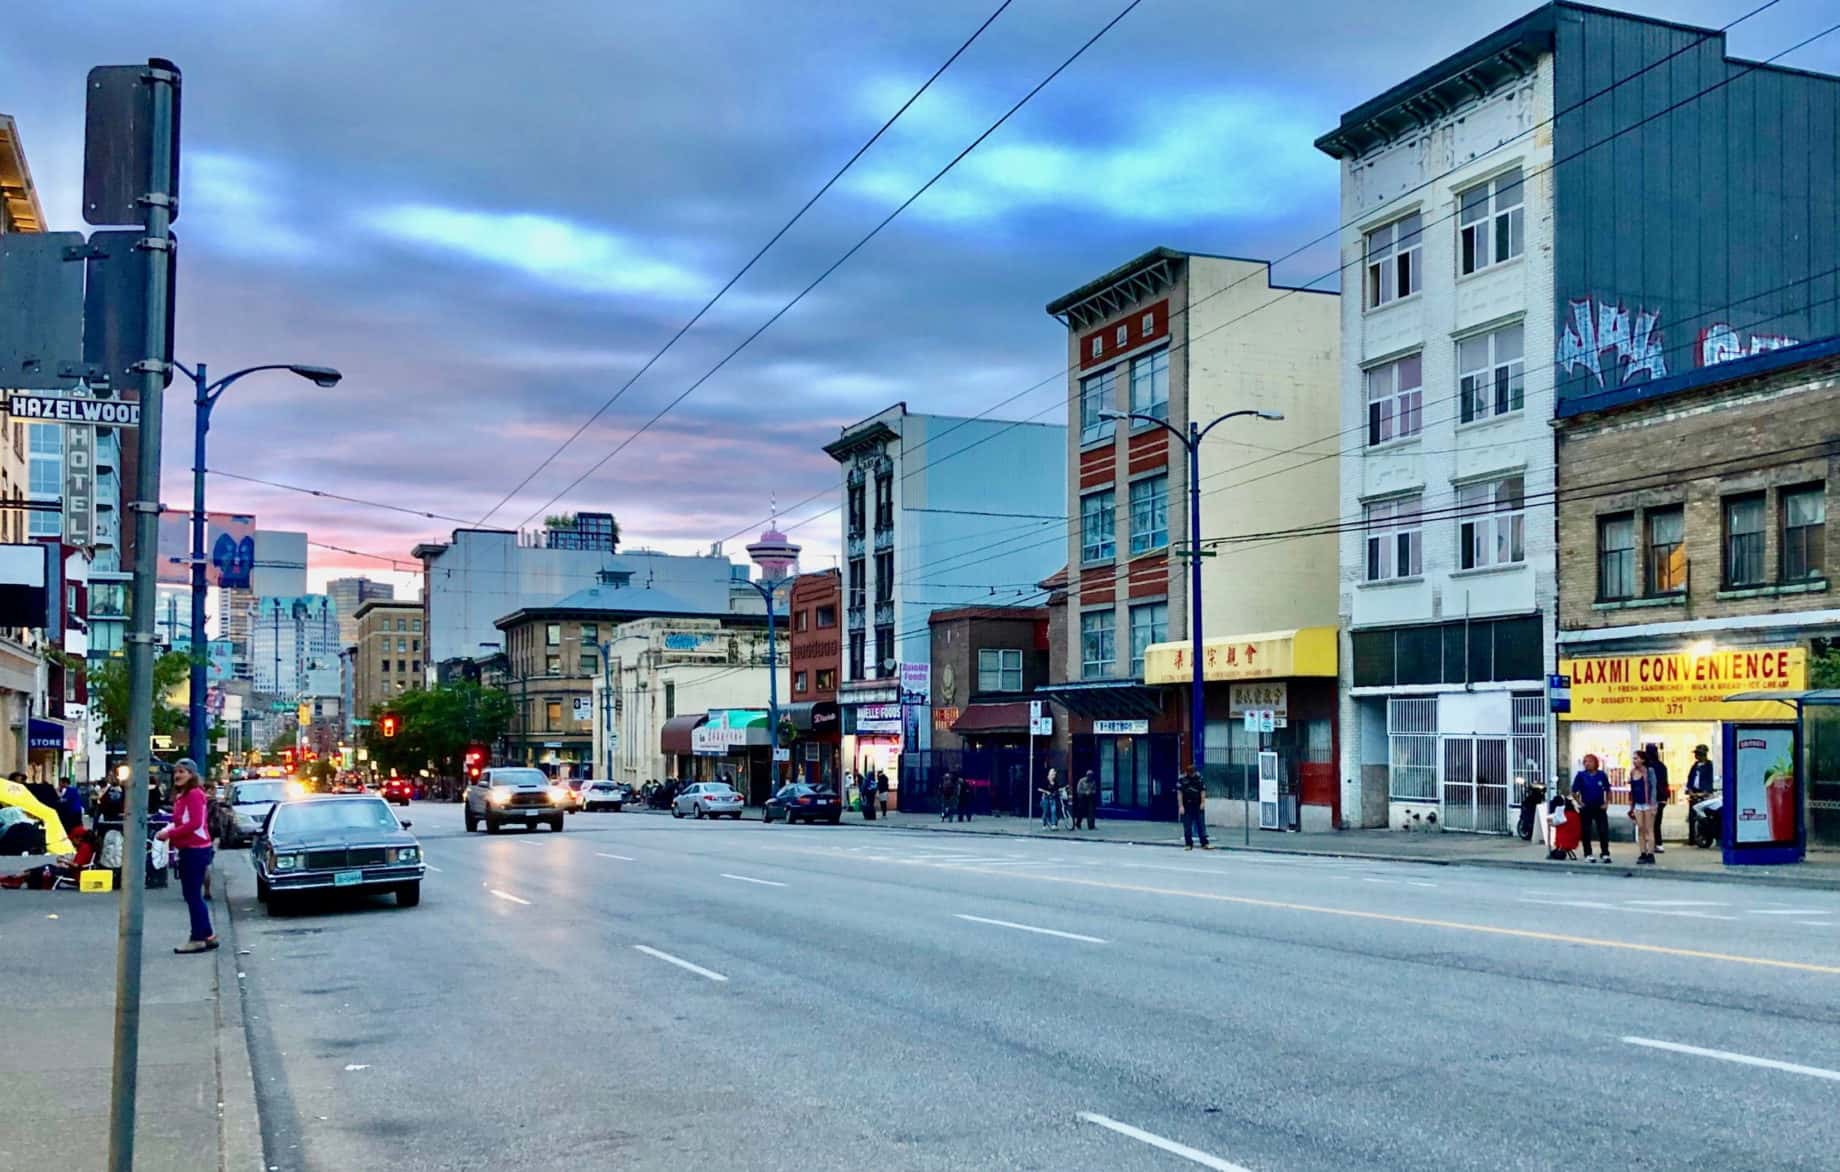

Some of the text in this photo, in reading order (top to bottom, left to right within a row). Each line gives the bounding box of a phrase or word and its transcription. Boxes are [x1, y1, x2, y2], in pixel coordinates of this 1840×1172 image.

[12, 397, 140, 423] HAZELWOOD
[70, 428, 89, 535] HOTEL
[1573, 651, 1788, 685] LAXMI CONVENIENCE
[1666, 704, 1683, 714] 371
[30, 738, 61, 747] STORE
